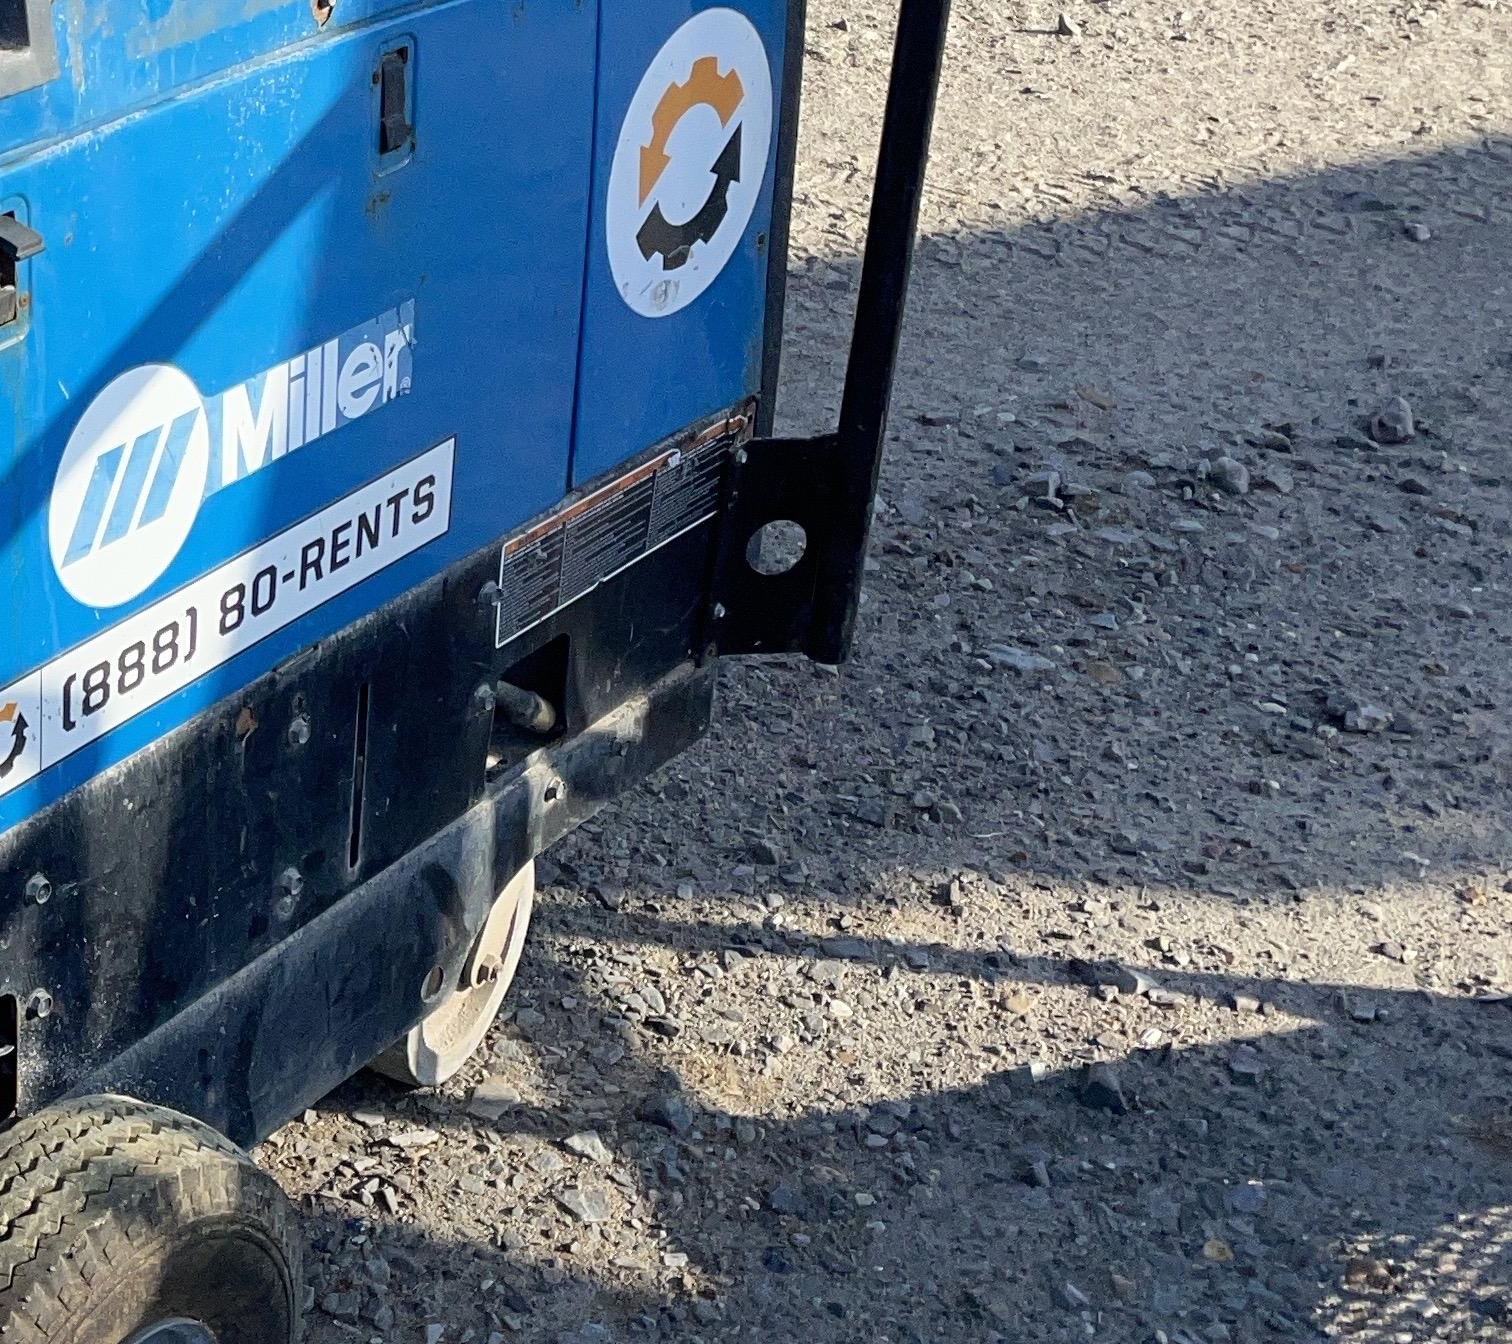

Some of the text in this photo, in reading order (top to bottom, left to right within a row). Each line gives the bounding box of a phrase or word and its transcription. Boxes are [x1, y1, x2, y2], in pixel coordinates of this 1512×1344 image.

[221, 323, 411, 487] Miller
[61, 609, 197, 733] (888)
[218, 474, 436, 637] 80-RENTS
